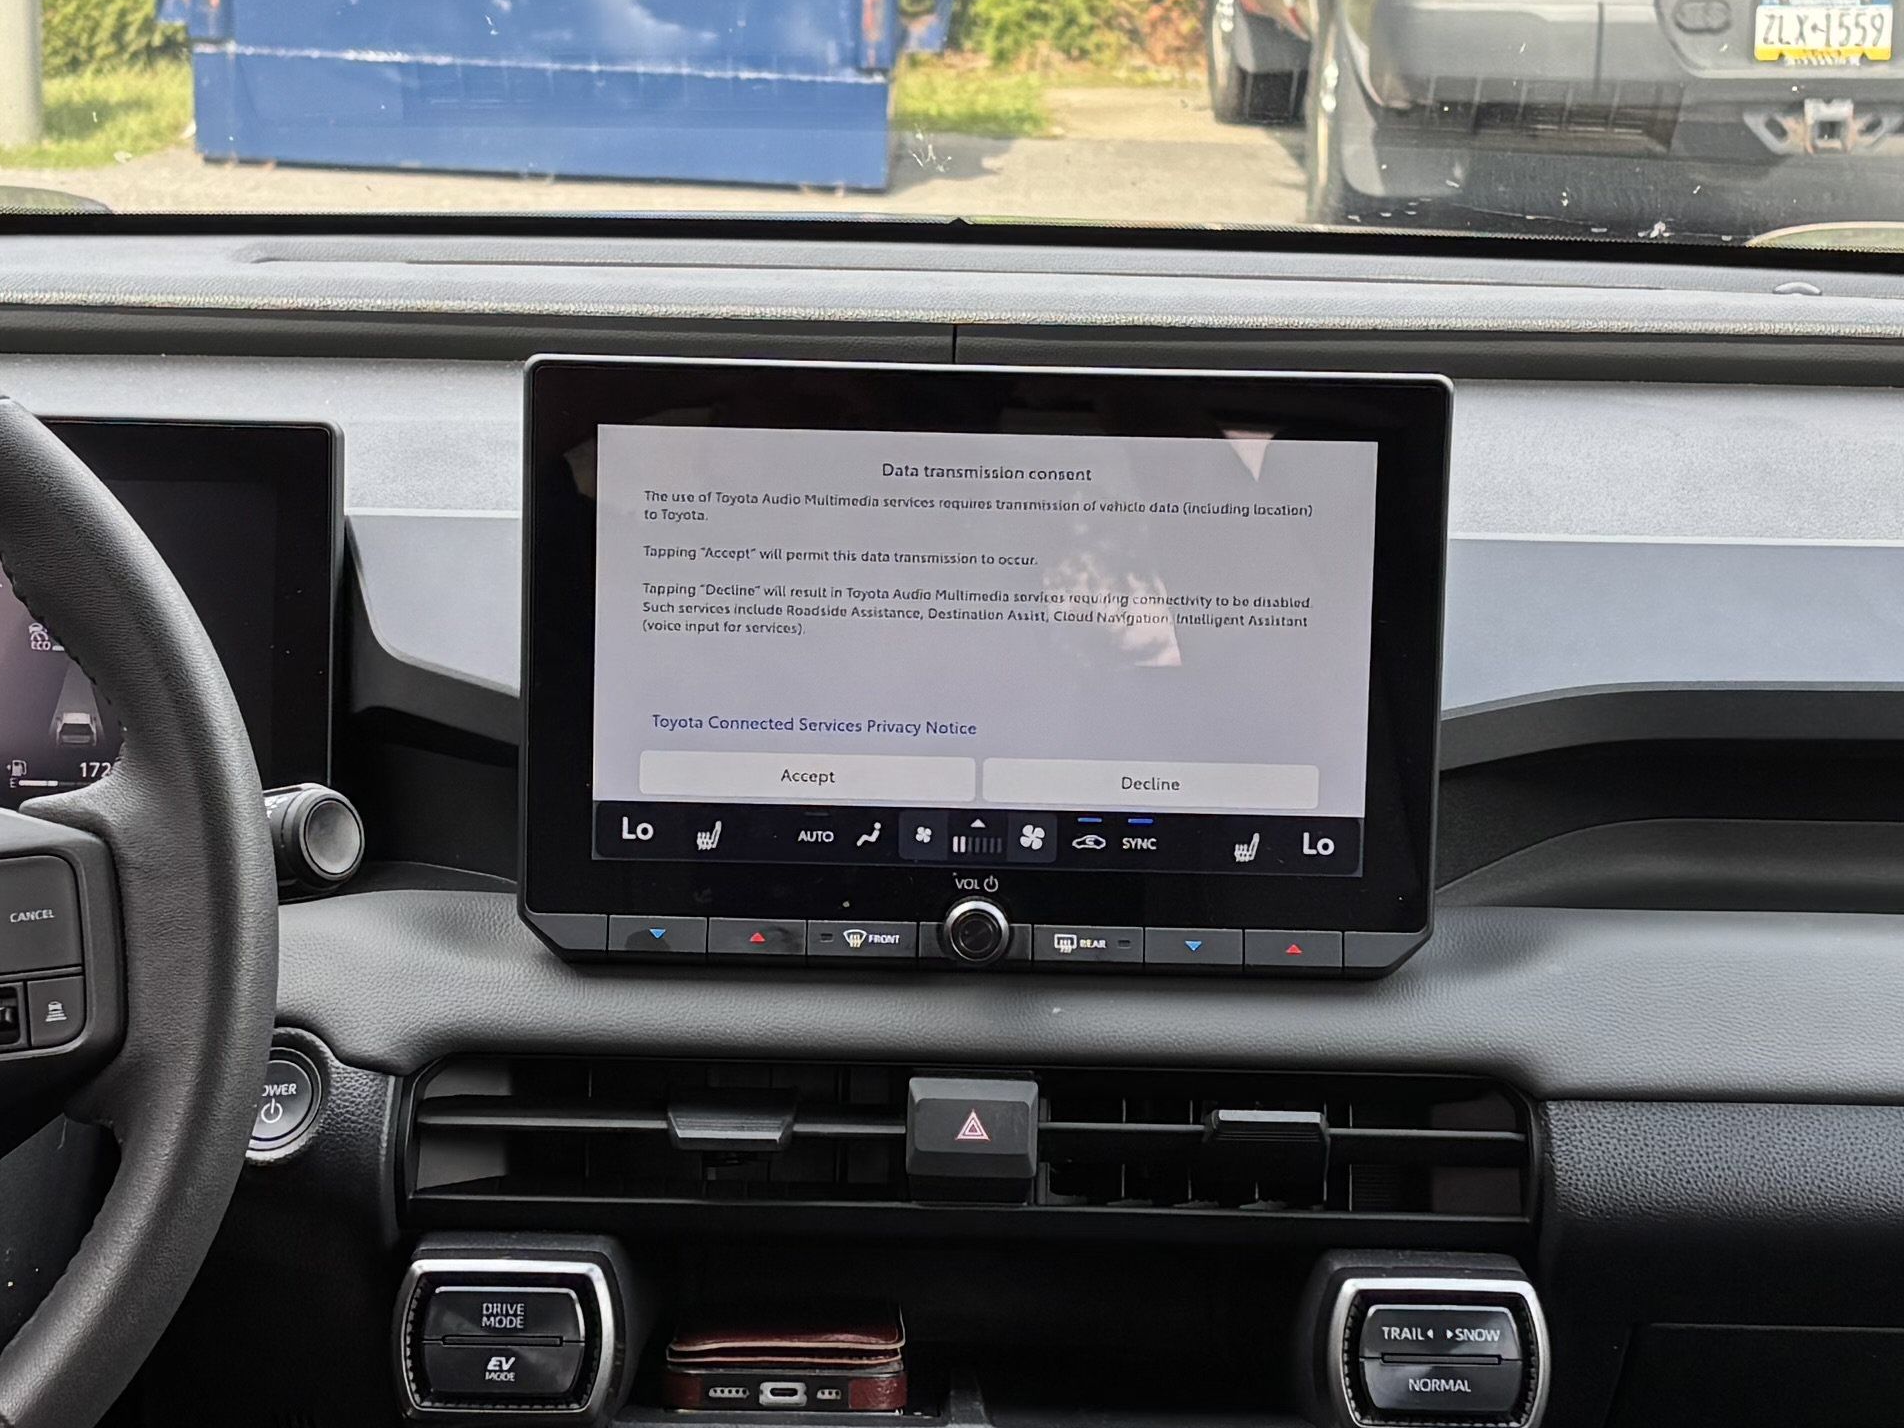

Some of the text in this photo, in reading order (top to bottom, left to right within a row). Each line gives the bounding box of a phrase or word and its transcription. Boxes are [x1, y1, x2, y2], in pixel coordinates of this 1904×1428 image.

[882, 463, 1092, 481] Data transmission consent
[645, 490, 1313, 518] The use of Toyota Audio Multimedia services requires transmission of vehicle data (including location)
[644, 509, 709, 523] to Toyota.
[643, 545, 697, 561] Tapping
[759, 548, 782, 561] will
[786, 549, 829, 564] permit
[833, 550, 857, 562] this
[861, 551, 890, 563] data
[894, 552, 978, 565] transmission
[981, 553, 995, 565] to
[999, 555, 1038, 566] occur.
[643, 582, 696, 598] Tapping
[764, 585, 787, 598] will
[790, 586, 827, 599] result
[831, 586, 843, 598] in
[846, 587, 889, 602] Toyota
[892, 588, 931, 601] Audio
[935, 589, 1009, 603] Multimedia
[1014, 592, 1065, 604] services
[1133, 594, 1212, 609] connectivity
[1215, 595, 1229, 607] to
[1233, 595, 1249, 607] be
[643, 601, 675, 614] Such
[678, 603, 730, 615] services
[734, 604, 782, 616] include
[786, 605, 847, 618] Roadside
[851, 606, 924, 621] Assistance,
[928, 608, 1003, 621] Destination
[1053, 610, 1093, 623] Cloud
[1176, 612, 1245, 628] Intelligent
[1248, 614, 1308, 628] Assistant
[642, 619, 681, 633] (voice
[684, 621, 720, 635] input
[723, 621, 742, 633] for
[30, 641, 51, 651] ECO
[652, 714, 977, 736] Toyota Connected Services Privacy Notice
[780, 769, 836, 785] Accept
[1121, 776, 1181, 792] Decline
[622, 816, 654, 840] Lo
[798, 830, 834, 843] AUTO
[1122, 837, 1157, 851] SYNC
[1302, 832, 1335, 856] Lo
[955, 878, 980, 890] VOL
[9, 908, 55, 924] CANCEL
[868, 933, 900, 945] FRONT
[1080, 939, 1107, 950] REAR
[262, 1083, 297, 1097] OWER
[482, 1303, 525, 1315] DRIVE
[481, 1316, 524, 1329] MODE
[1382, 1326, 1501, 1342] TRAIL SNOW
[487, 1356, 516, 1371] EV
[485, 1371, 516, 1382] MODE
[1408, 1377, 1472, 1393] NORMAL
